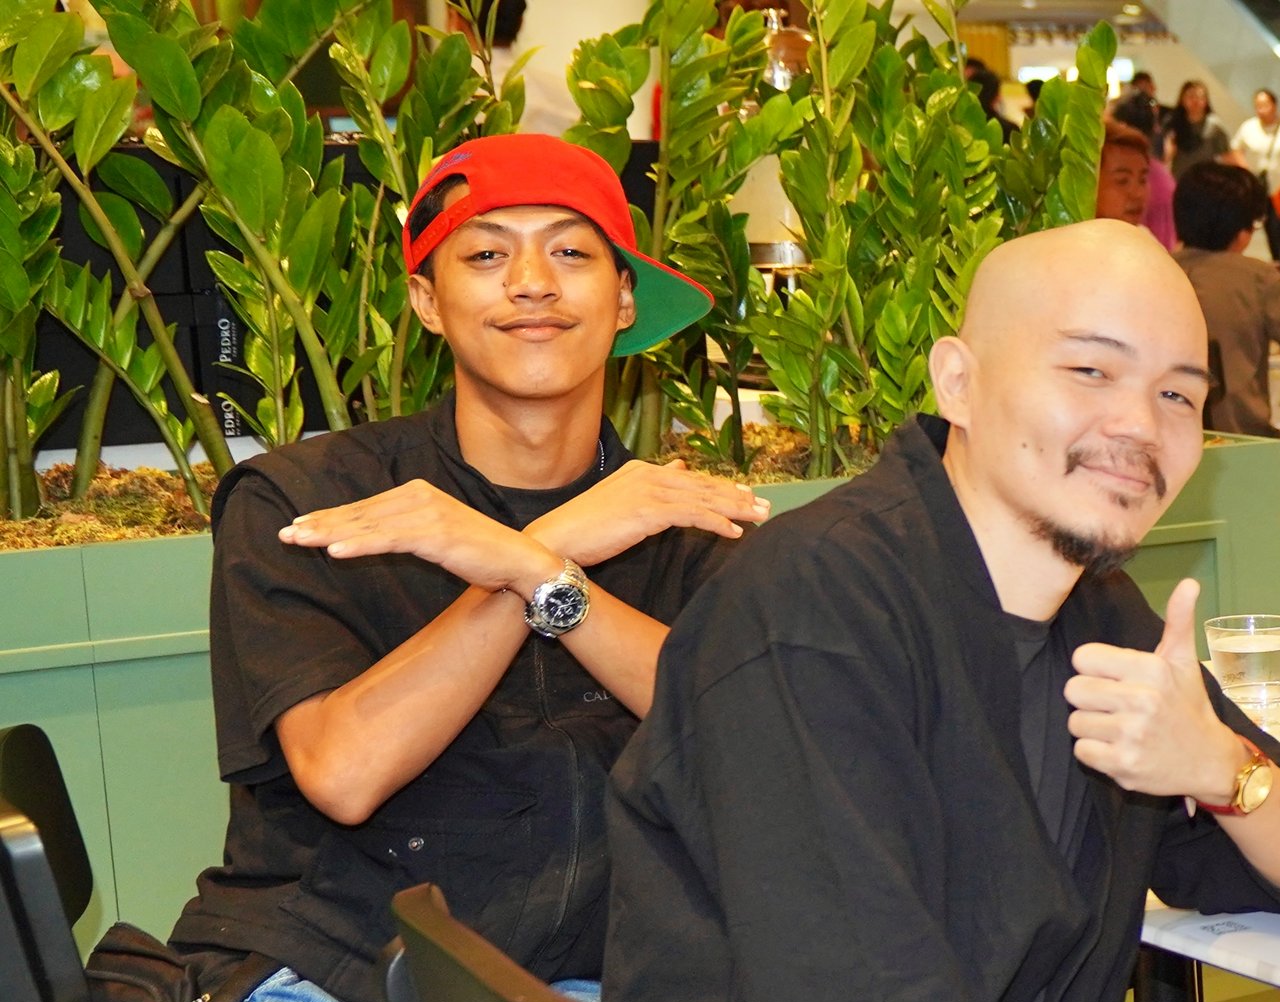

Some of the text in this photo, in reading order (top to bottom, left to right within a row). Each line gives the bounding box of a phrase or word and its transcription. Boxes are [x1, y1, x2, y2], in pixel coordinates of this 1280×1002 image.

[218, 318, 231, 362] PEDRO
[221, 400, 235, 435] EDRO
[583, 690, 611, 702] CAL
